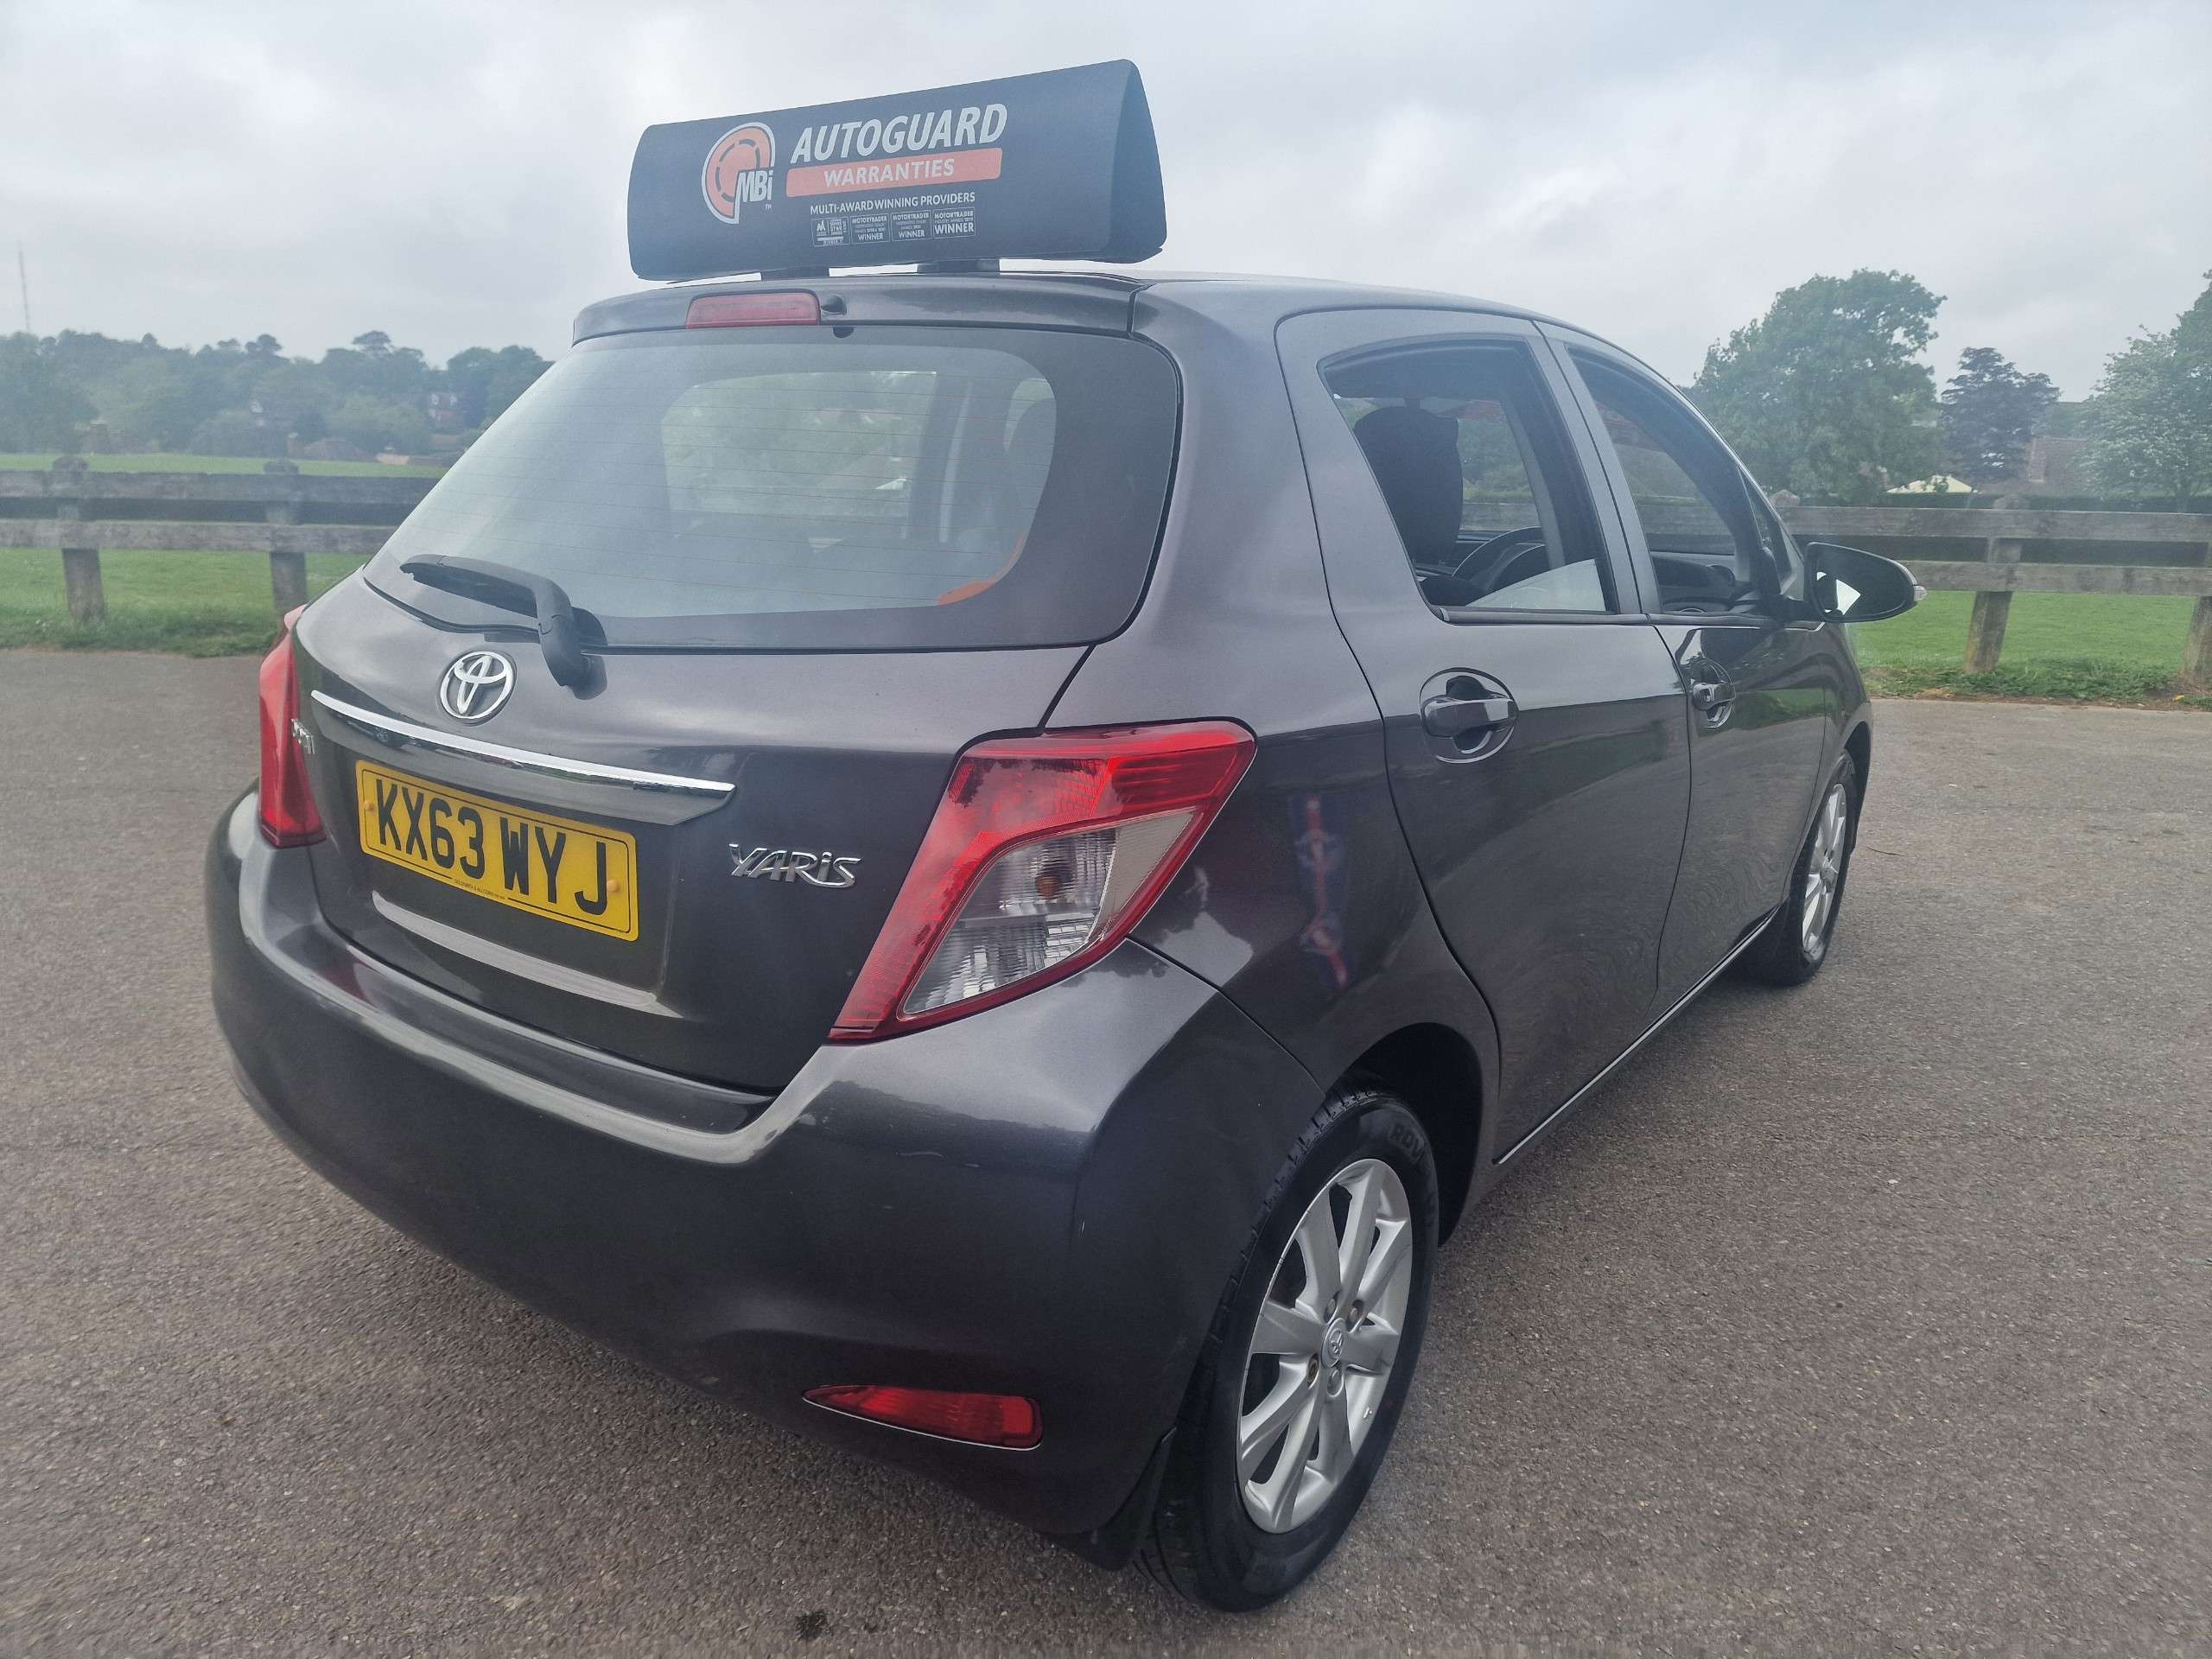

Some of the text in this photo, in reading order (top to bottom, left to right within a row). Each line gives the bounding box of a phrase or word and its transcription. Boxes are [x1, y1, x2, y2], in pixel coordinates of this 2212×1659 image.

[790, 104, 1007, 164] AUTOGUARD
[823, 158, 955, 188] WARRANTIES
[810, 191, 976, 215] MULTI-AWARD WINNING PROVIDERS
[857, 232, 884, 241] WINNER
[898, 229, 925, 238] WINNER
[934, 222, 975, 235] WINNER
[376, 779, 608, 916] KX63 WYJ
